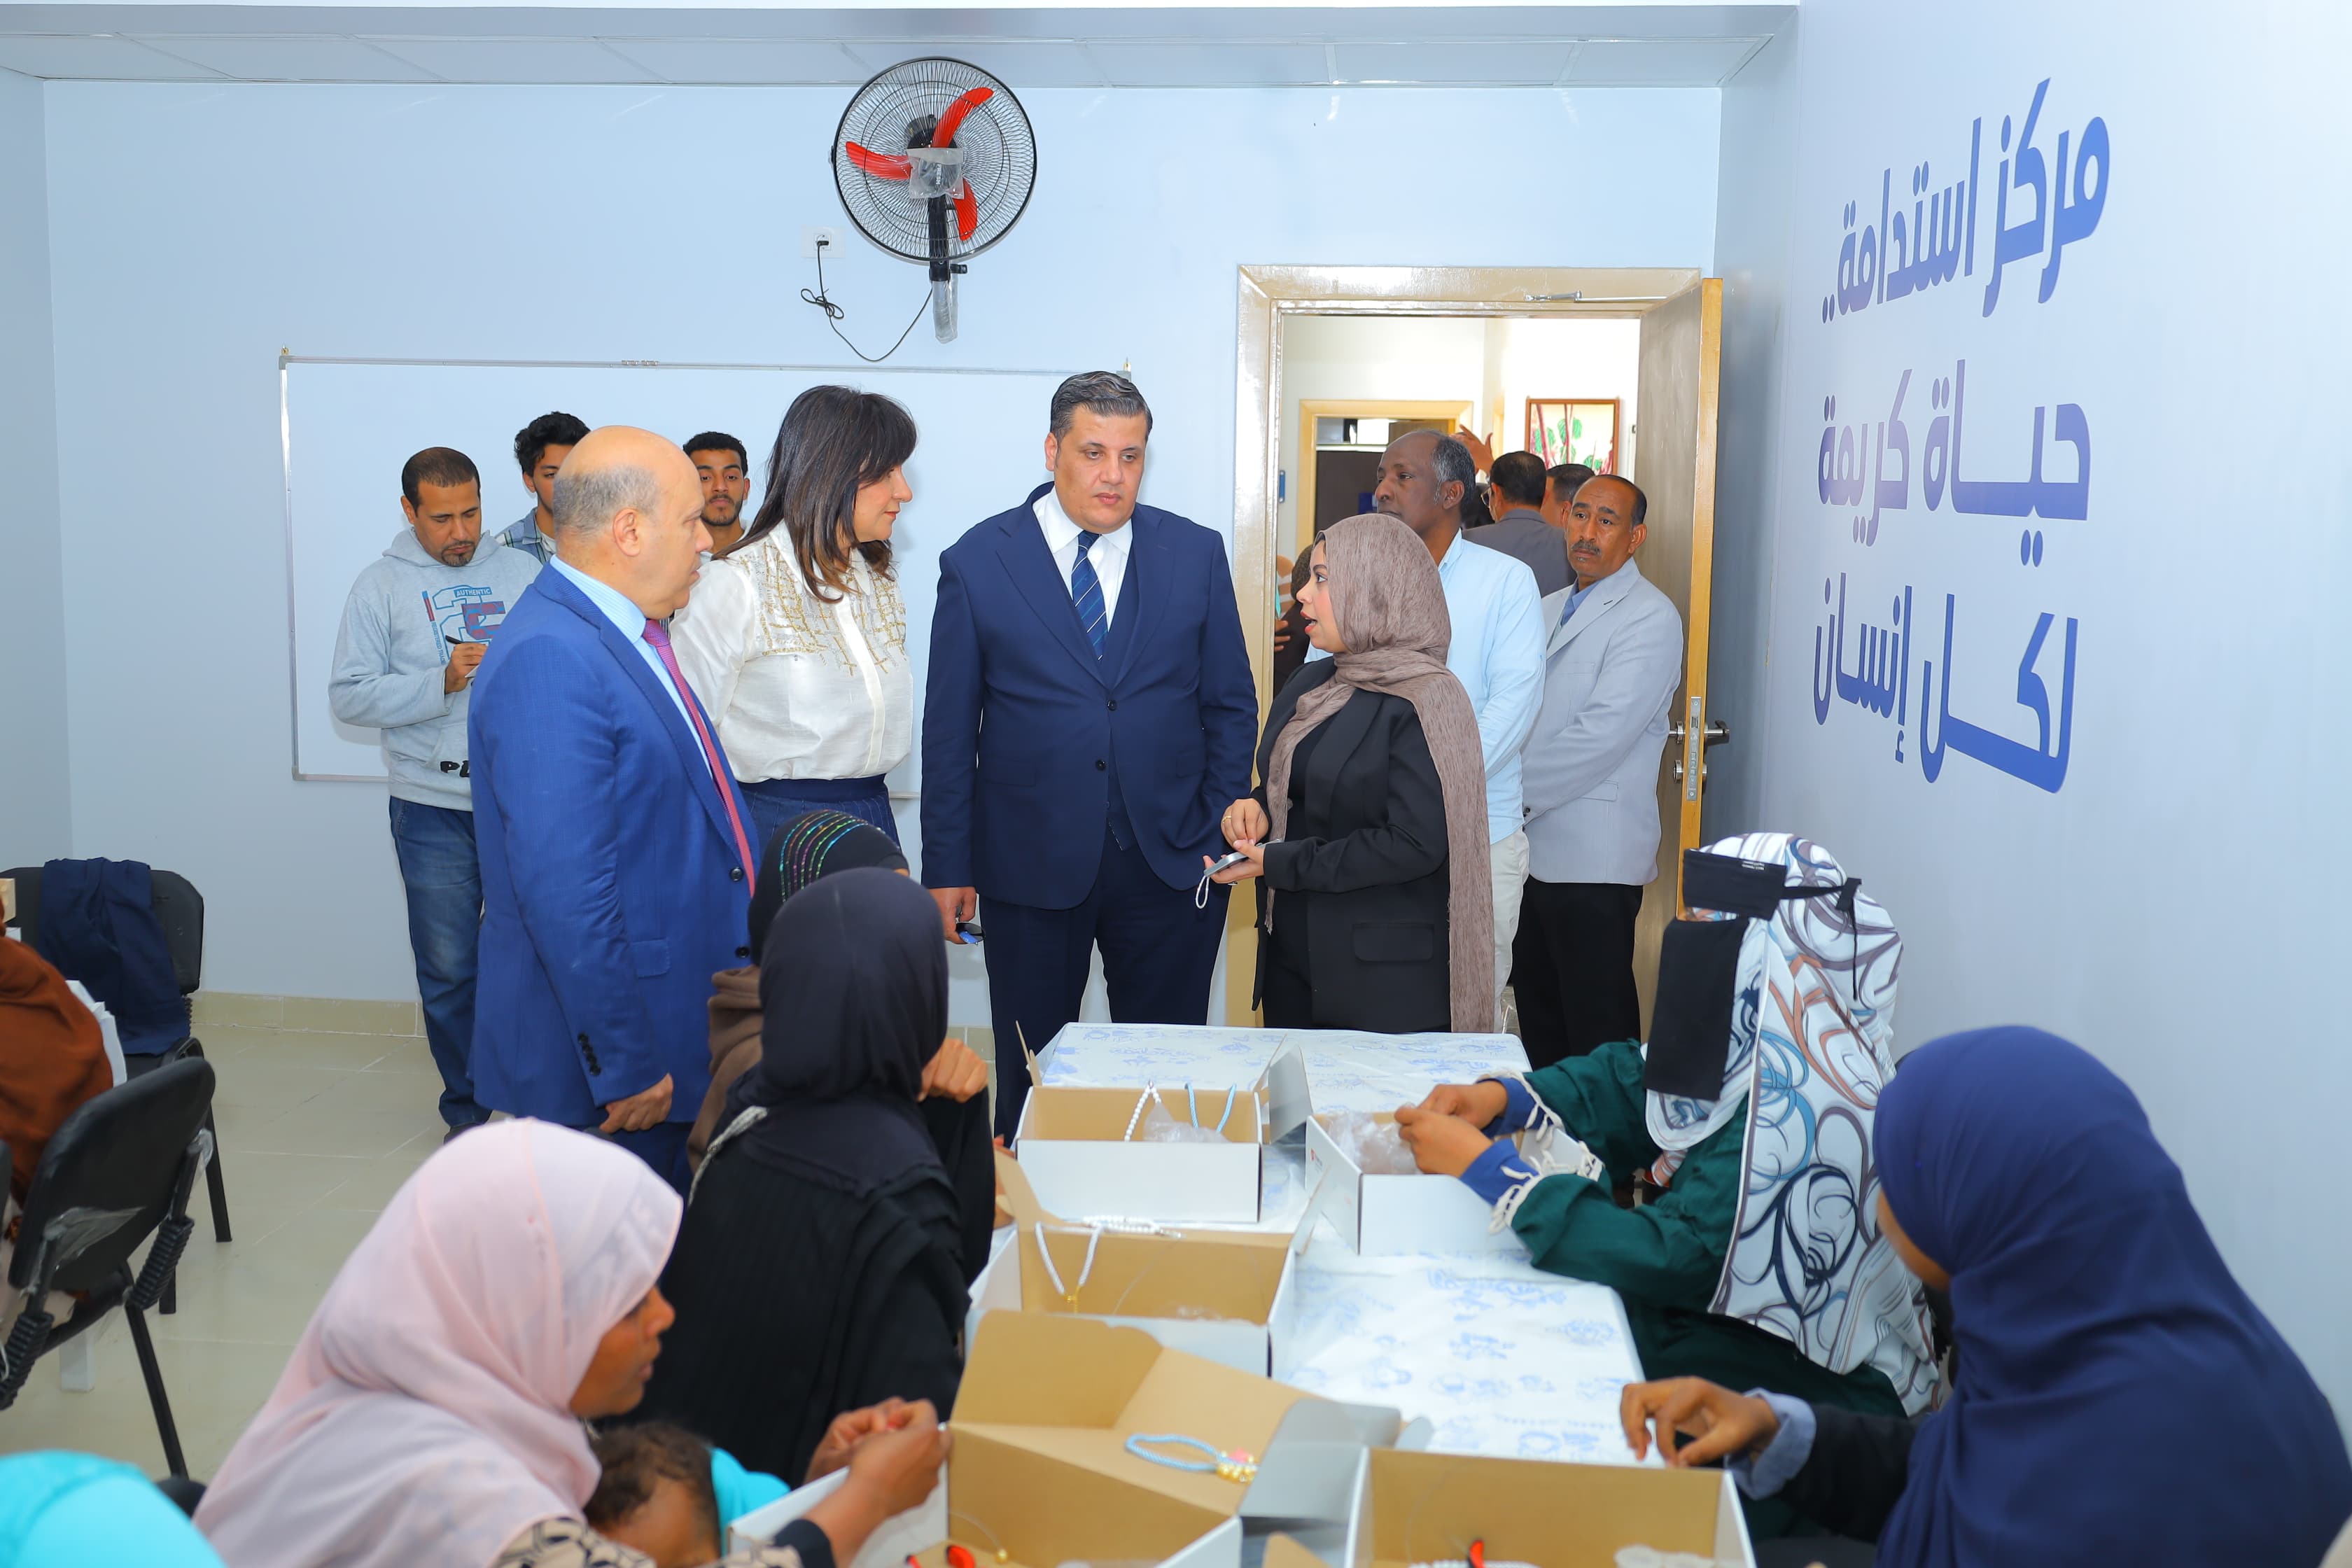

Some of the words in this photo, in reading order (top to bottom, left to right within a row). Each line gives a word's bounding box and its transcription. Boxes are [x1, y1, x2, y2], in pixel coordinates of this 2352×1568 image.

[1982, 77, 2110, 318] مركز
[1818, 368, 1912, 547] كريمة
[1923, 358, 2091, 568] حياة
[456, 588, 491, 596] AUTHENTIC
[1813, 572, 1912, 764] إنسان
[1919, 593, 2079, 794] لكل
